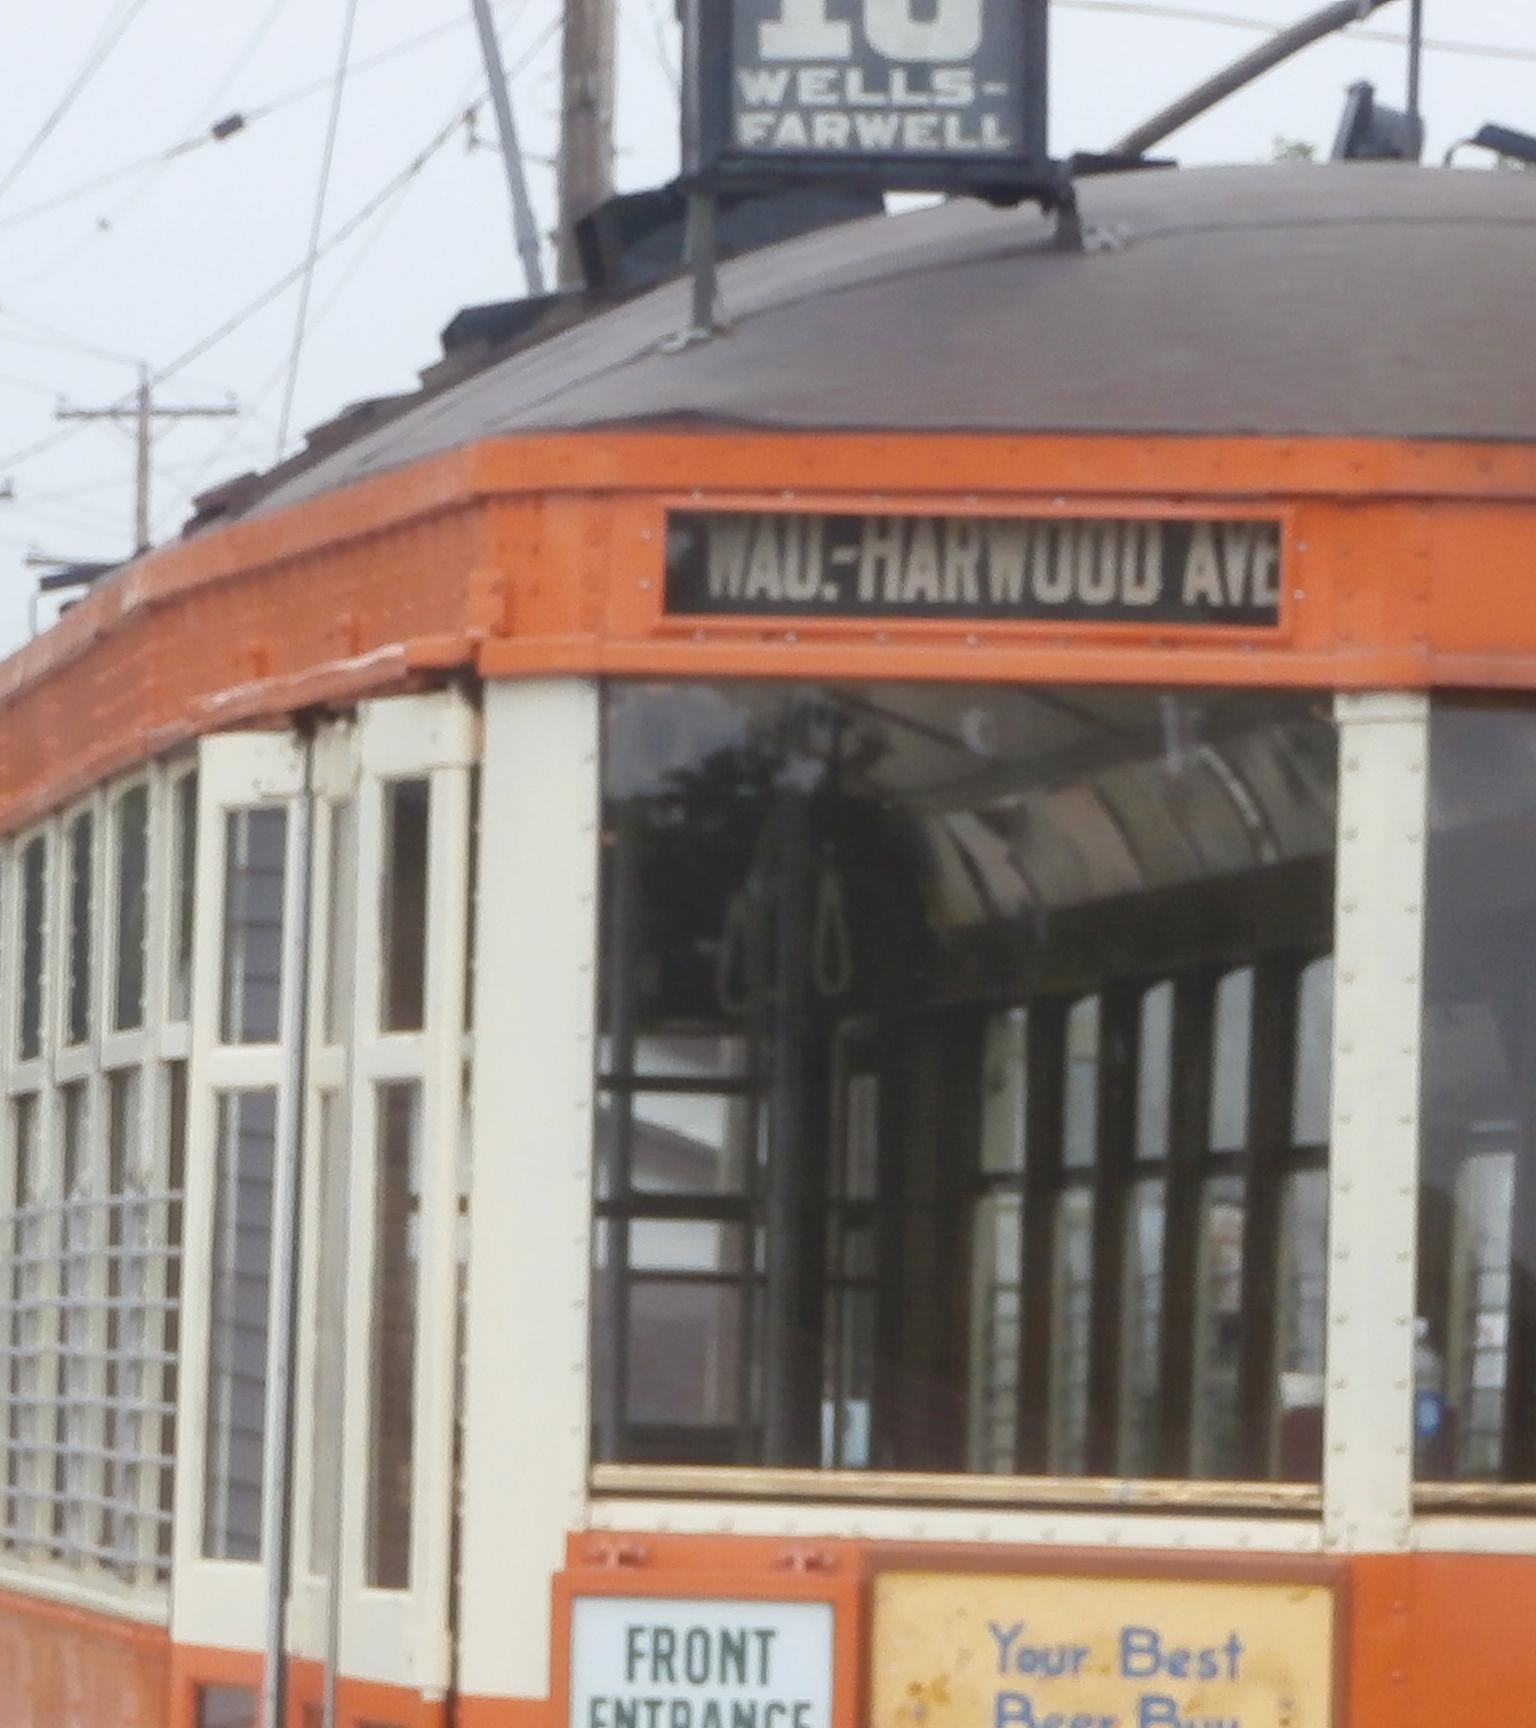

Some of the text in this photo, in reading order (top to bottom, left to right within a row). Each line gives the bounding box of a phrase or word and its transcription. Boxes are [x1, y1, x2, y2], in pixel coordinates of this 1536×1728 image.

[734, 66, 1009, 106] WELLS-
[734, 110, 1011, 150] FARWELL
[626, 1624, 777, 1686] FRONT
[987, 1620, 1243, 1682] Your Best
